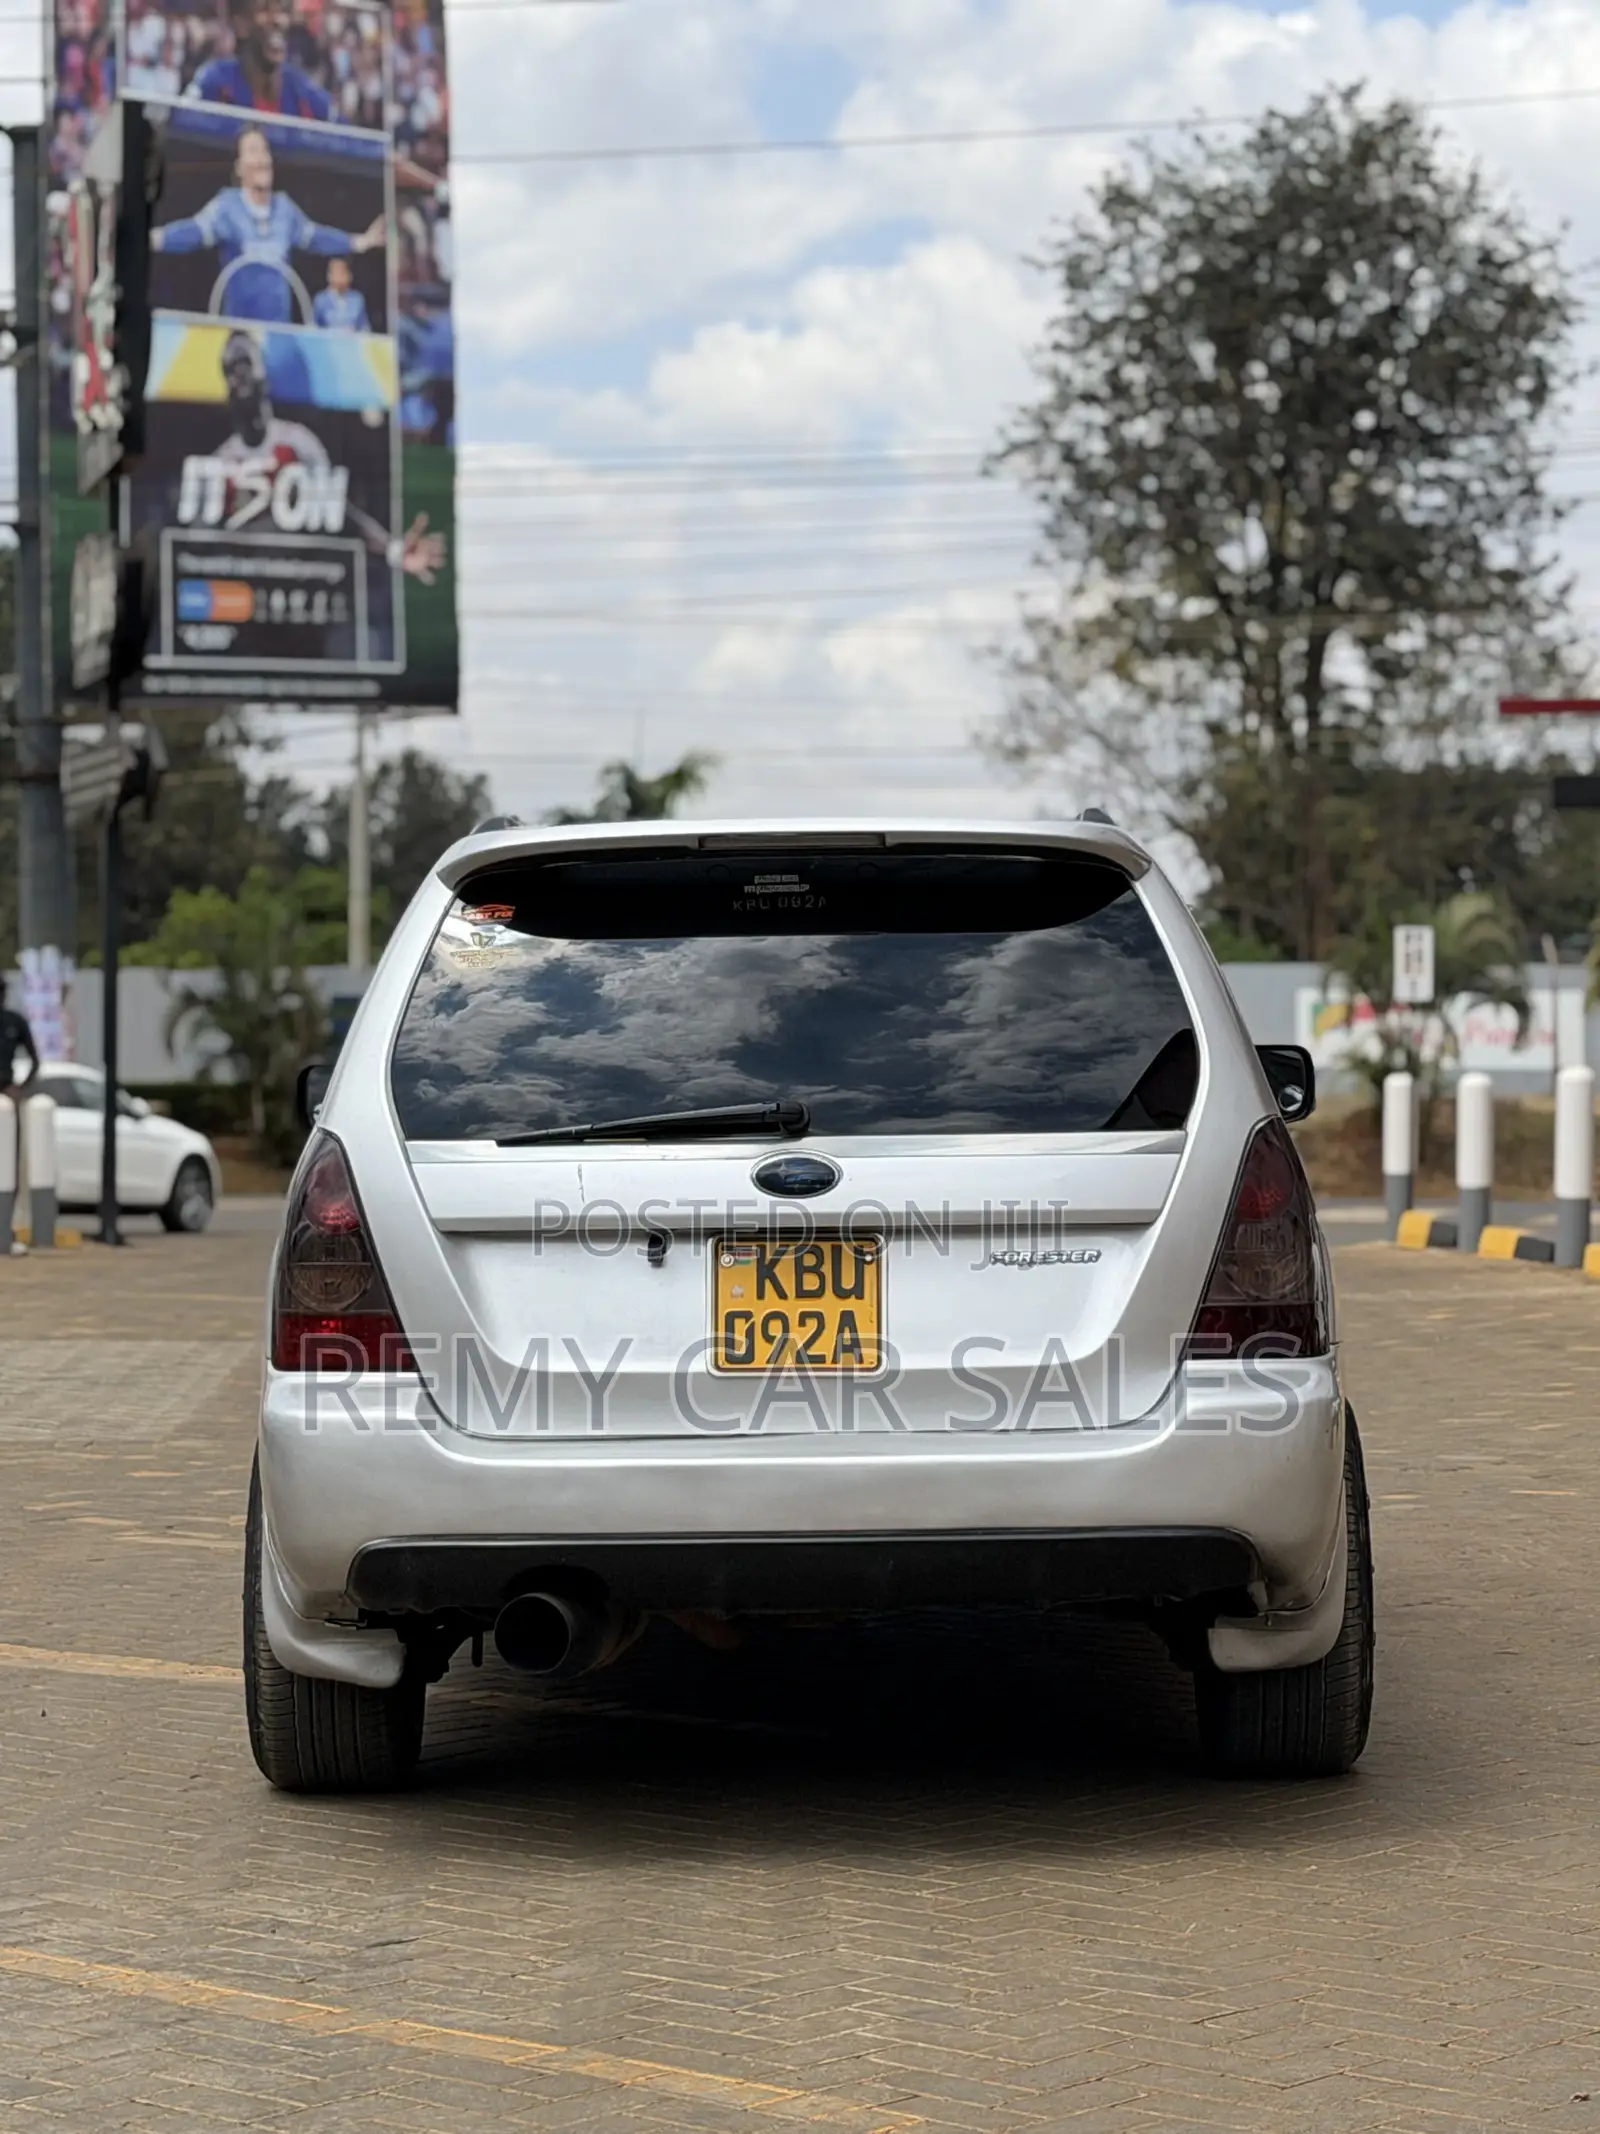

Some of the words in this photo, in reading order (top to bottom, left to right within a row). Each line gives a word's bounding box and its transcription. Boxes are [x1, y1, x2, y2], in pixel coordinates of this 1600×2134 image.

[756, 1244, 865, 1300] KBU
[989, 1248, 1102, 1266] FORESTER
[724, 1310, 865, 1365] 092A
